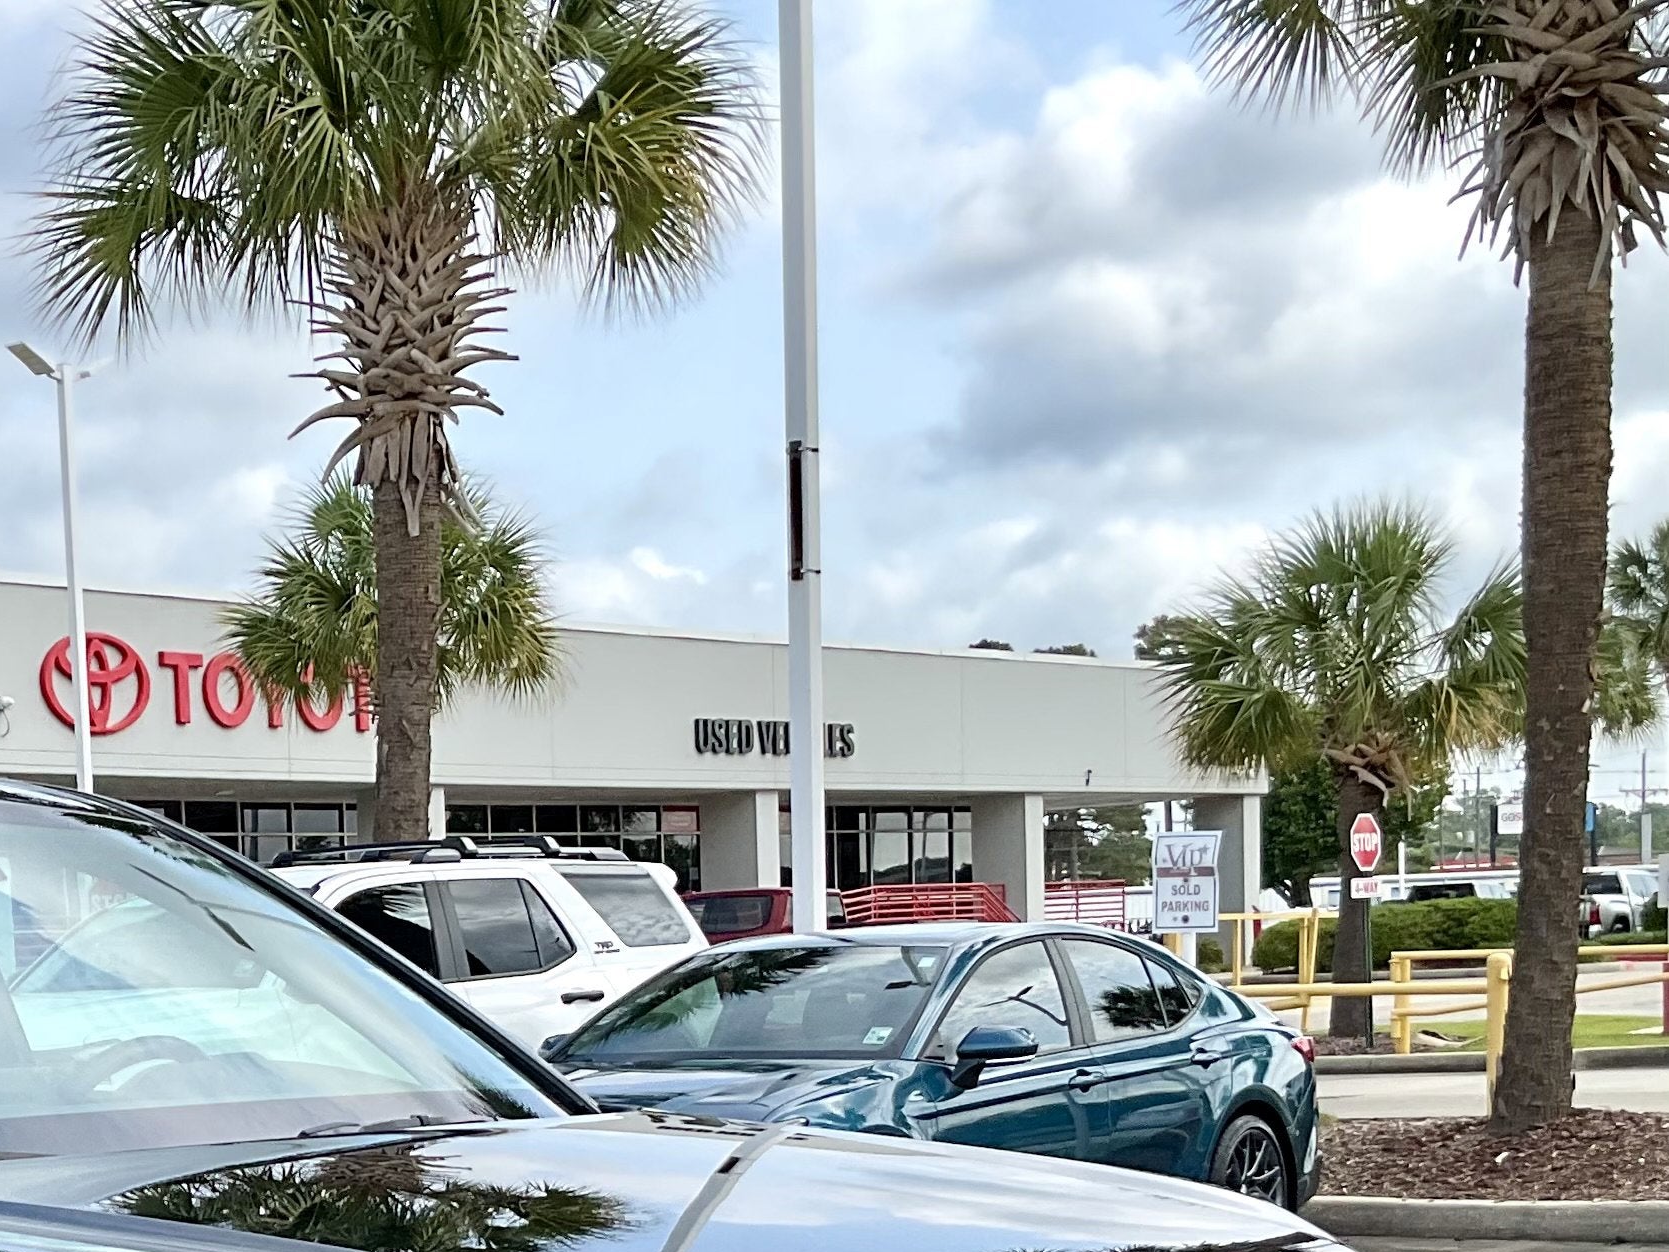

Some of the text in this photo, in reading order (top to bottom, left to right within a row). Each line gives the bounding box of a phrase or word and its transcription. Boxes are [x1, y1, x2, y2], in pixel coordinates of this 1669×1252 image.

[694, 719, 754, 755] USED
[1353, 832, 1378, 852] STOP
[1171, 884, 1201, 896] SOLD
[1355, 883, 1379, 894] 4-WAY
[1161, 900, 1210, 912] PARKING
